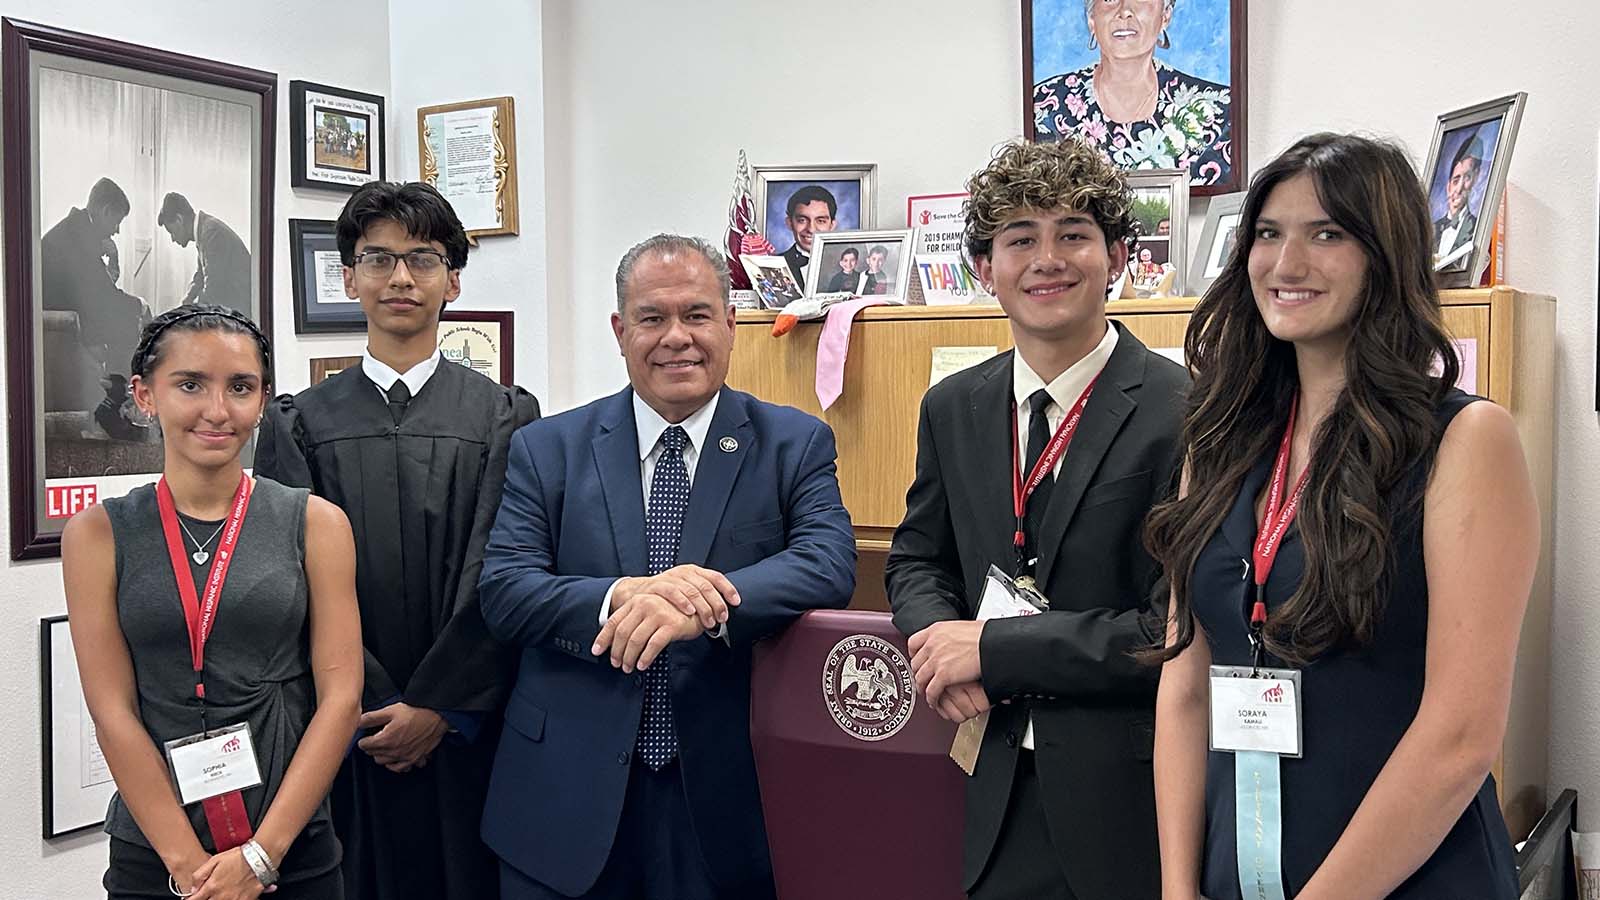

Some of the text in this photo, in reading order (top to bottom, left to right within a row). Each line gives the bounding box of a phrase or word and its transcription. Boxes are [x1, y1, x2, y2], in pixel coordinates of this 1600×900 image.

[924, 232, 961, 242] 2019 CHAM
[927, 244, 939, 252] FOR
[920, 263, 975, 290] THANK
[949, 287, 968, 296] YOU
[444, 330, 455, 339] Public
[483, 333, 492, 343] With
[443, 349, 462, 358] nea
[1032, 413, 1081, 486] NATIONAL HISPANIC INSTITUTE
[48, 487, 95, 516] LIFE
[225, 494, 247, 545] NATIONAL HISPANIC
[1262, 522, 1283, 557] NATIONAL
[206, 586, 217, 614] HISPANIC
[212, 560, 225, 587] INSTITUTE
[839, 641, 857, 653] THE
[860, 639, 889, 654] STATE
[831, 654, 840, 666] OF
[892, 655, 904, 666] OF
[901, 671, 911, 694] NEW
[830, 700, 852, 728] GREAT
[884, 699, 910, 732] MEXICO
[858, 726, 878, 736] 1912
[203, 762, 226, 774] SOPHIA
